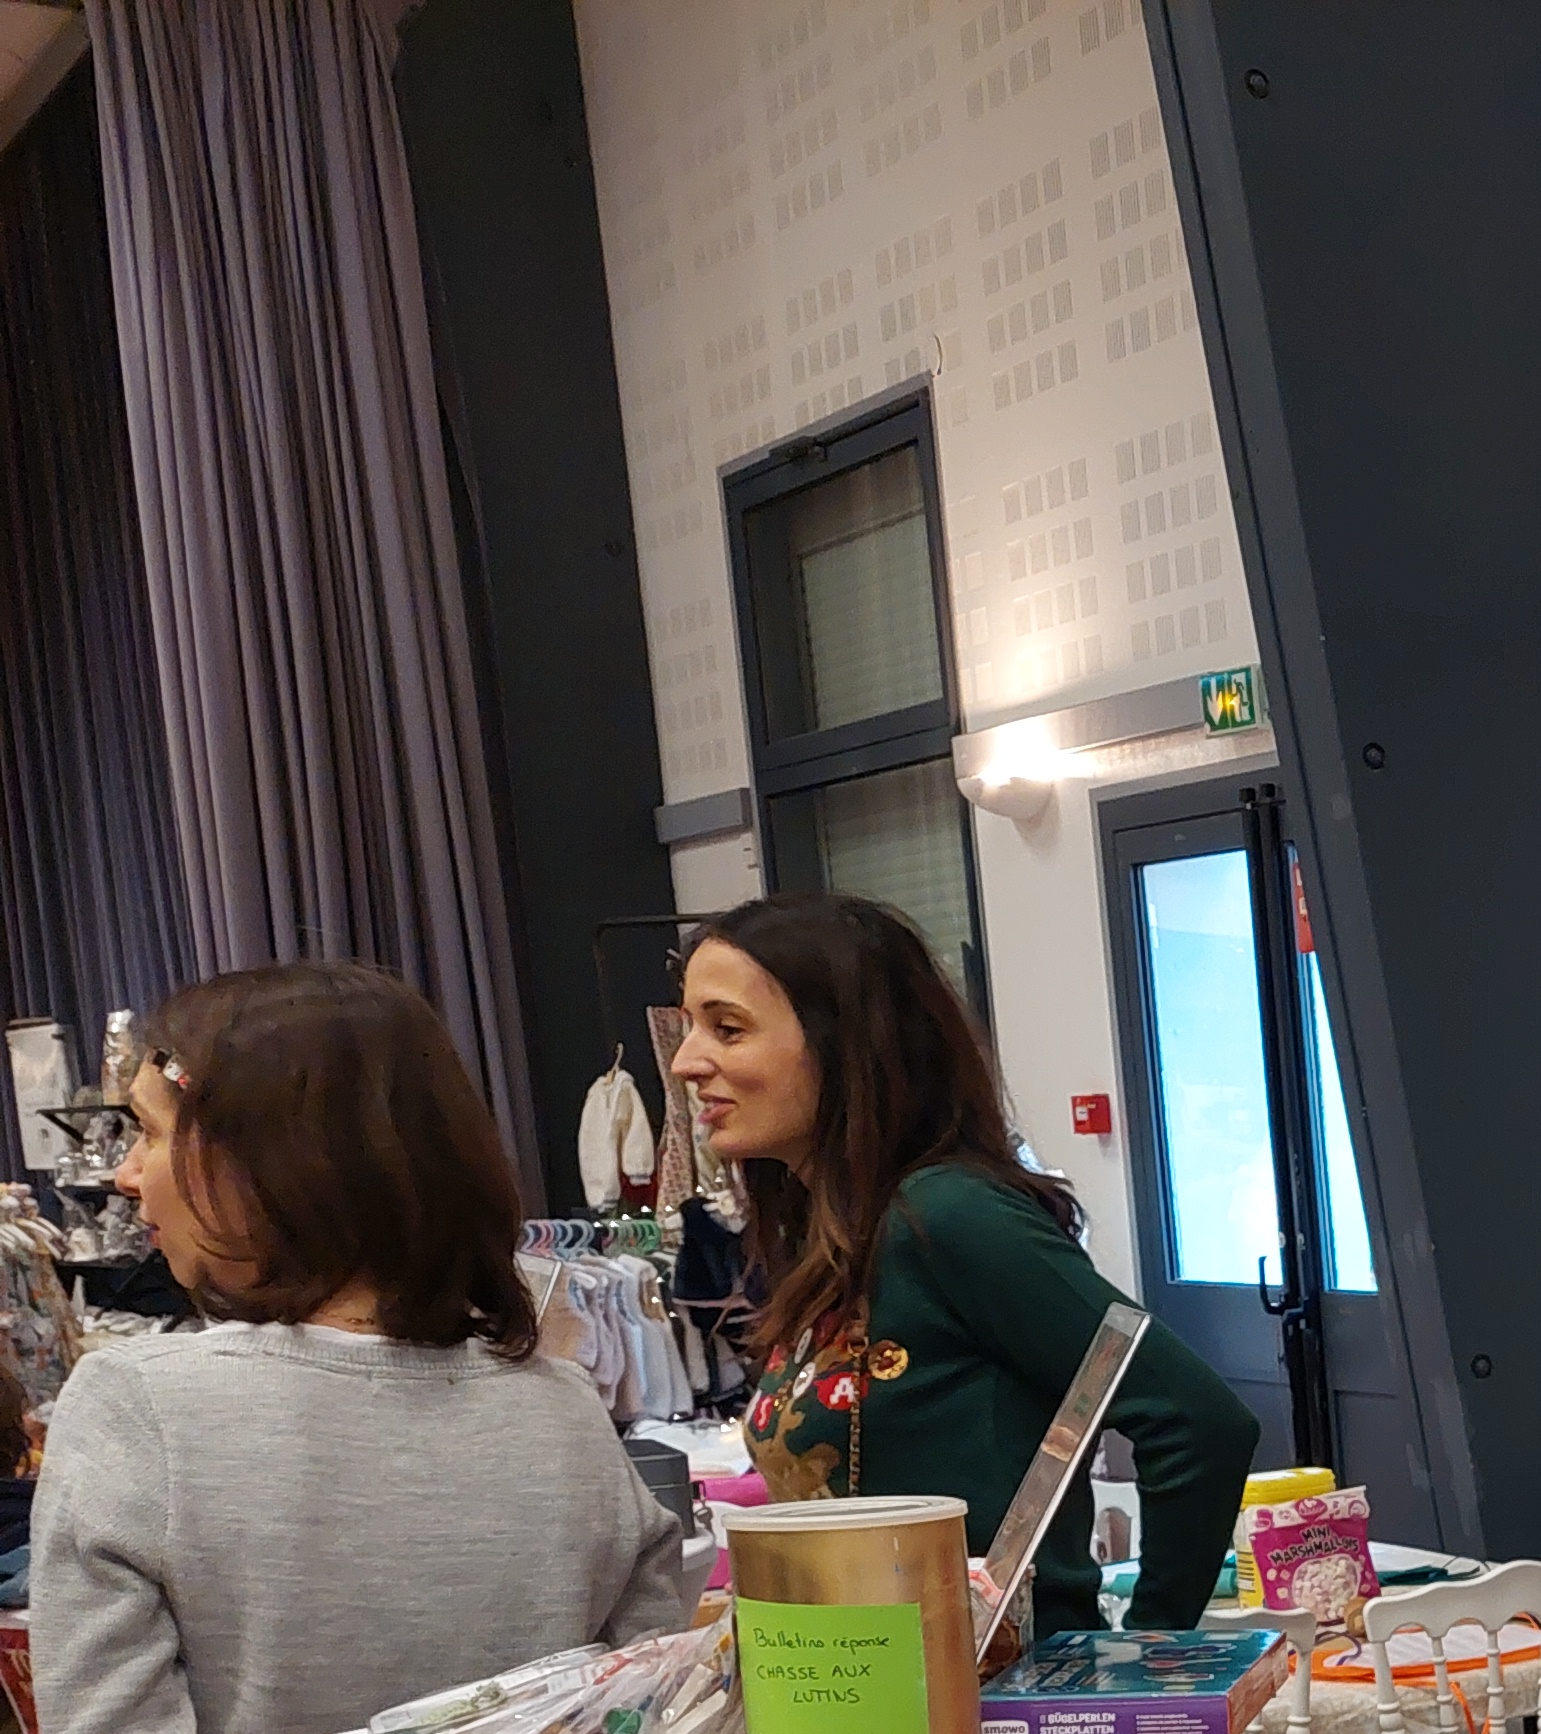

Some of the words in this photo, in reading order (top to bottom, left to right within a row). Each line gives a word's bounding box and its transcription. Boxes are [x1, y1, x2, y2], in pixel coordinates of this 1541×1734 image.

[1302, 1524, 1331, 1542] MINI
[753, 1628, 825, 1649] Bulletins
[833, 1636, 890, 1655] réponse
[756, 1665, 820, 1680] CHASSE
[831, 1664, 871, 1679] AUX
[793, 1688, 861, 1704] LUTINS
[983, 1726, 1026, 1734] smowo
